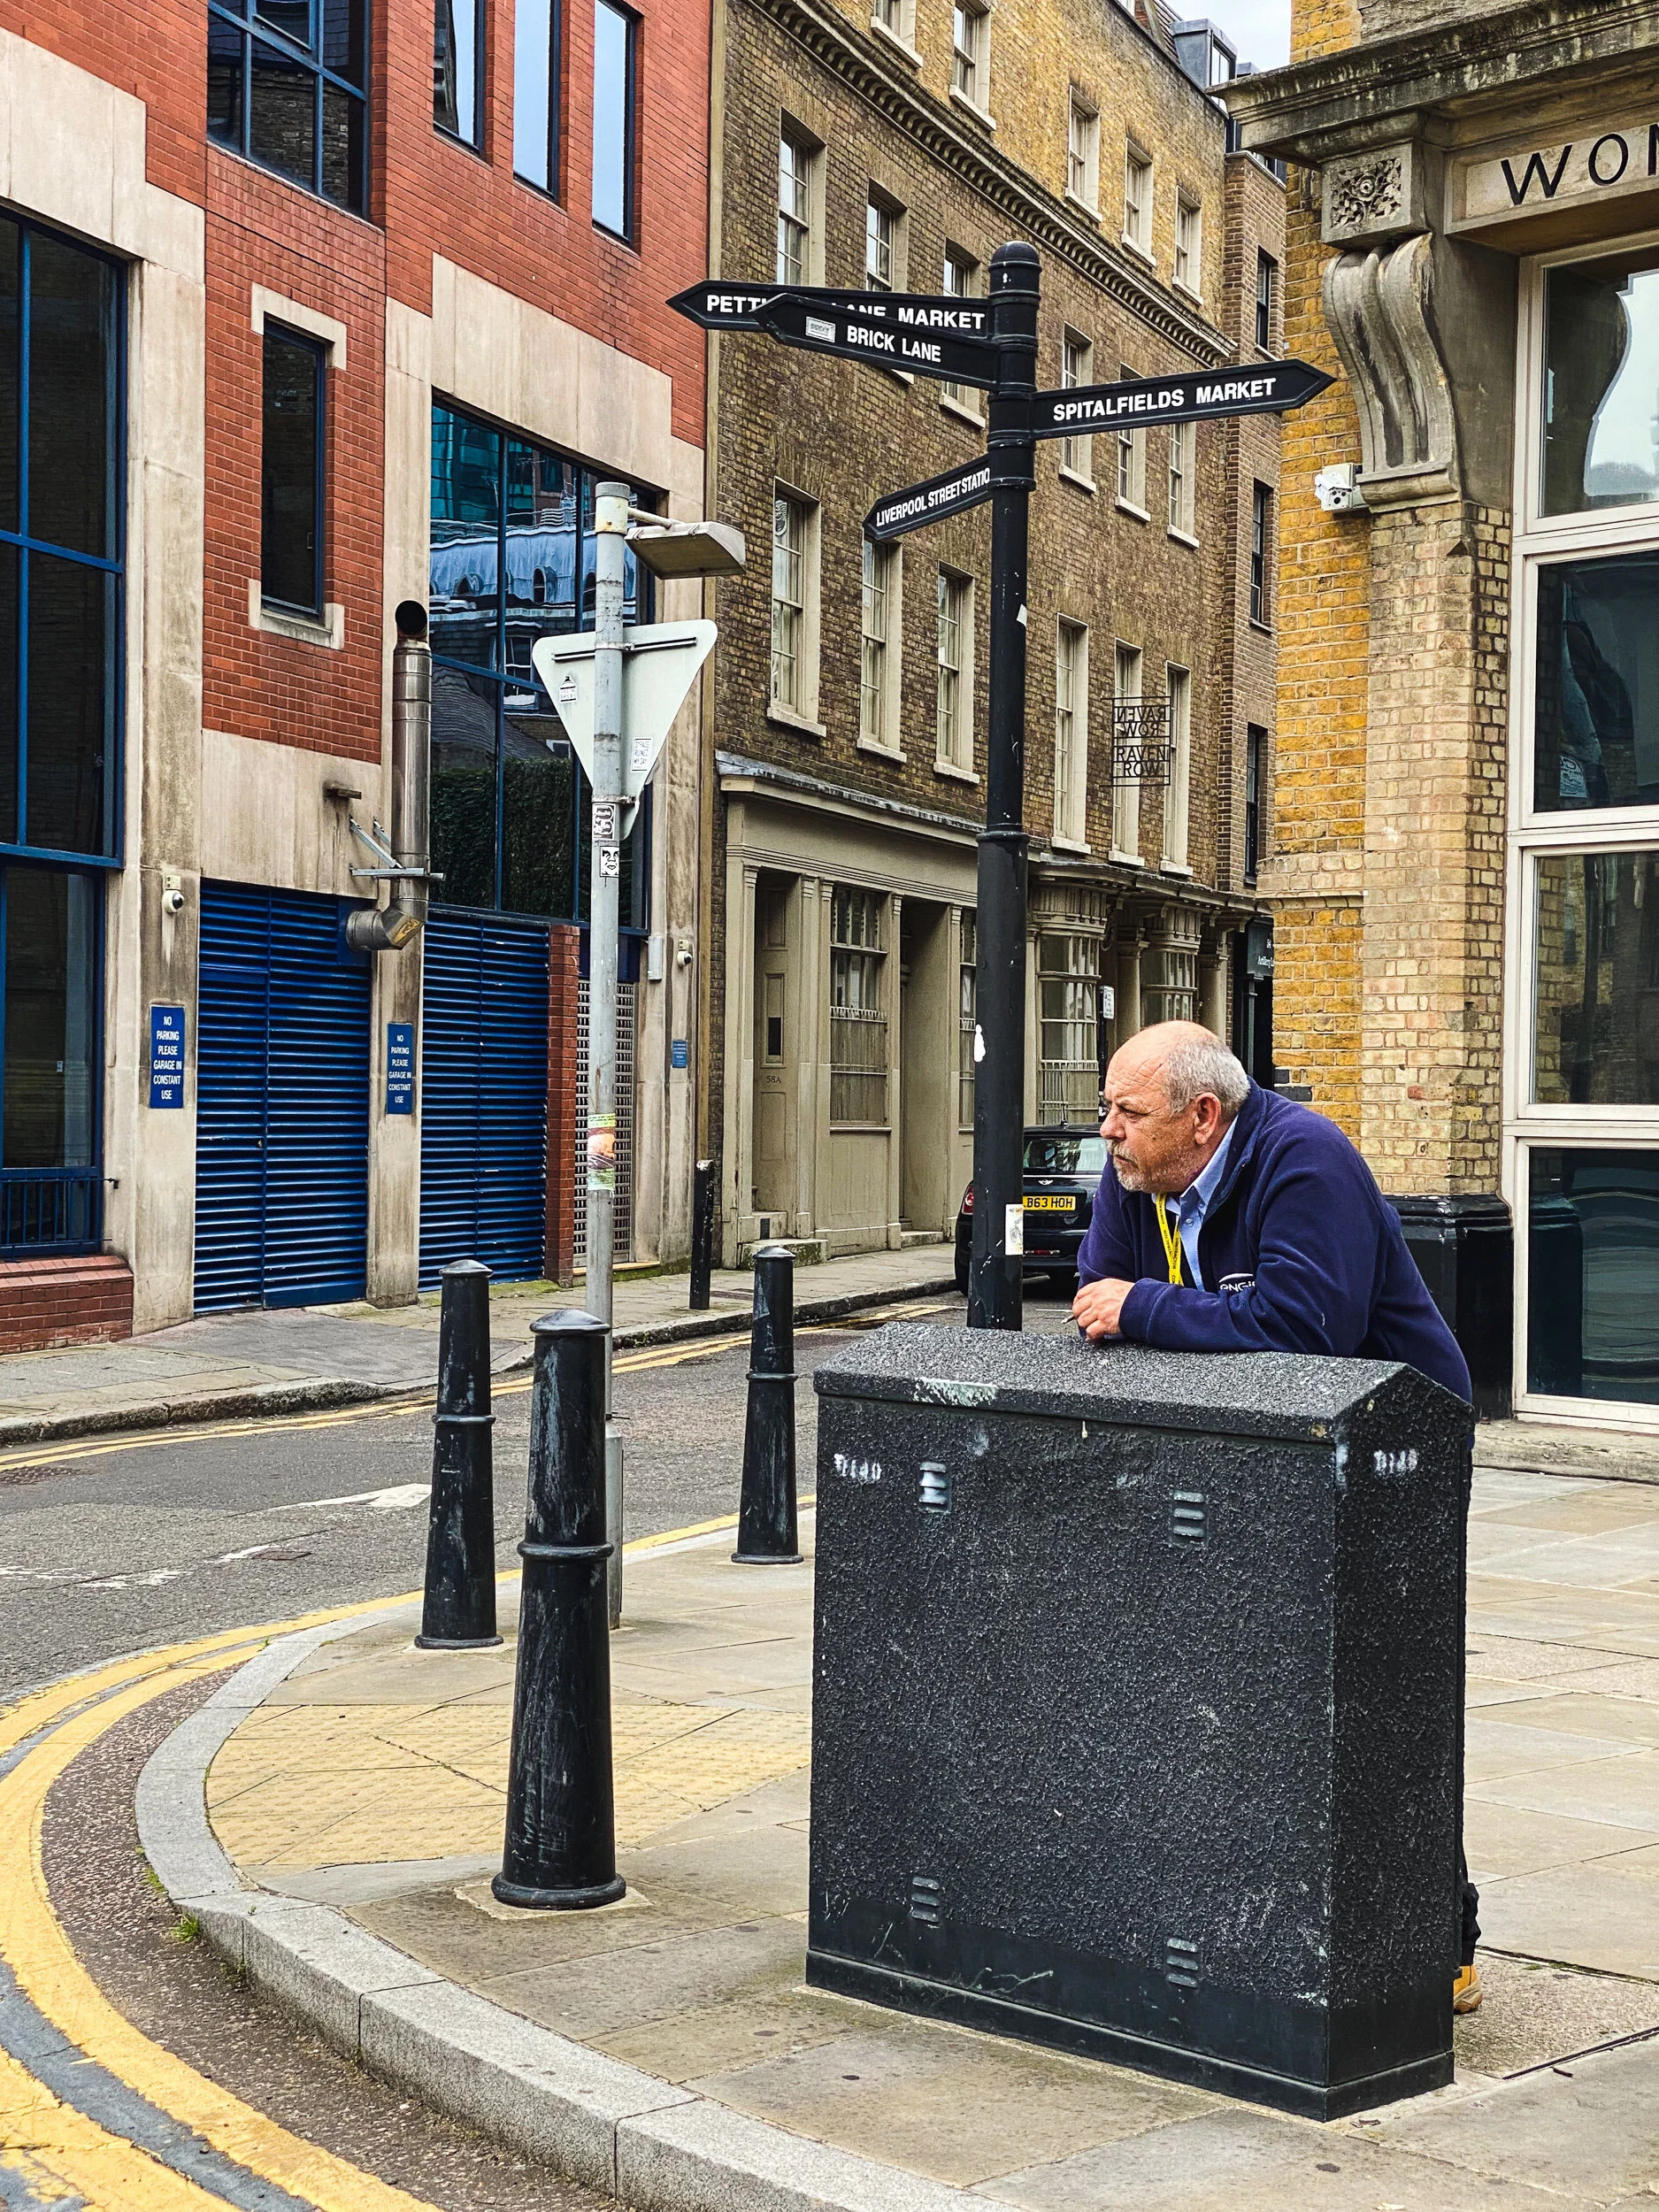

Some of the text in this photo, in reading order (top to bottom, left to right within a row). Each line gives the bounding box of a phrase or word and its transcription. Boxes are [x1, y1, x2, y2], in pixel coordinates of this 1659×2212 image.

[898, 308, 986, 330] MARKET
[847, 325, 895, 352] BRICK
[902, 338, 941, 363] LANE
[1053, 378, 1276, 422] SPITALFIELDS MARKET
[876, 495, 927, 527] LIVERPOOL
[927, 480, 962, 508] STREET
[1117, 746, 1165, 761] RAVEN
[1124, 762, 1161, 777] ROW
[163, 1016, 173, 1026] NO
[156, 1030, 180, 1041] PARKING
[157, 1045, 178, 1056] PLEASE
[153, 1060, 182, 1070] GARAGE IN
[392, 1058, 409, 1067] PLEASE
[153, 1074, 181, 1085] CONSTANT
[161, 1089, 173, 1100] USE
[1023, 1197, 1072, 1208] B63 HOH
